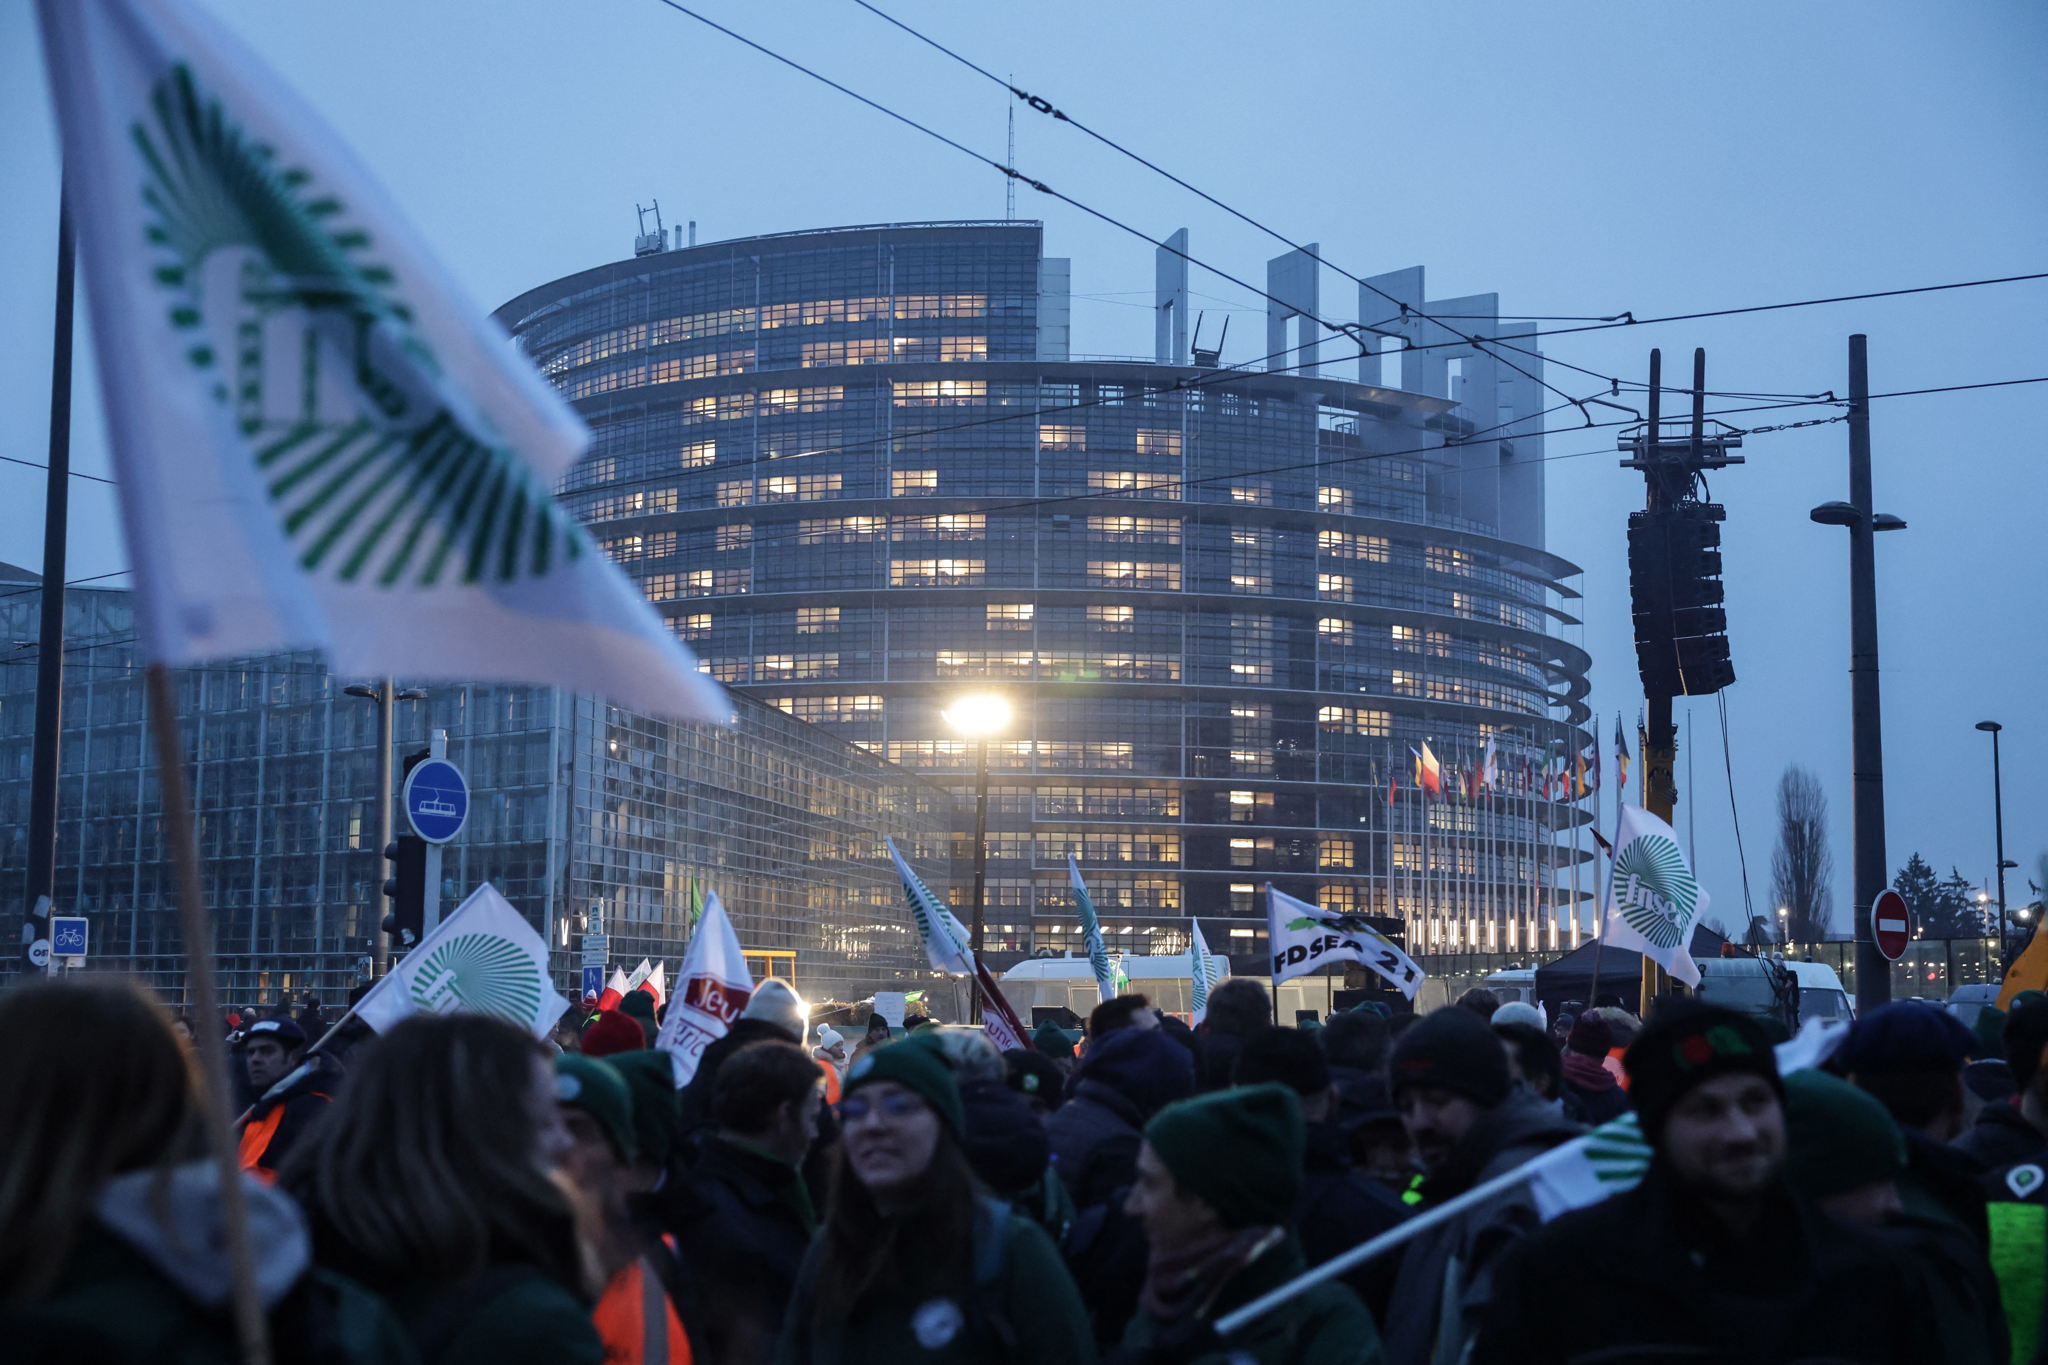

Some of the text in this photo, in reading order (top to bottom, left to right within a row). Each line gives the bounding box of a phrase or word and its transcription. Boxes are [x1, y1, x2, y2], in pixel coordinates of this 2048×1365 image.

[1273, 934, 1415, 983] FDSEA 21
[693, 979, 742, 1024] Jeu
